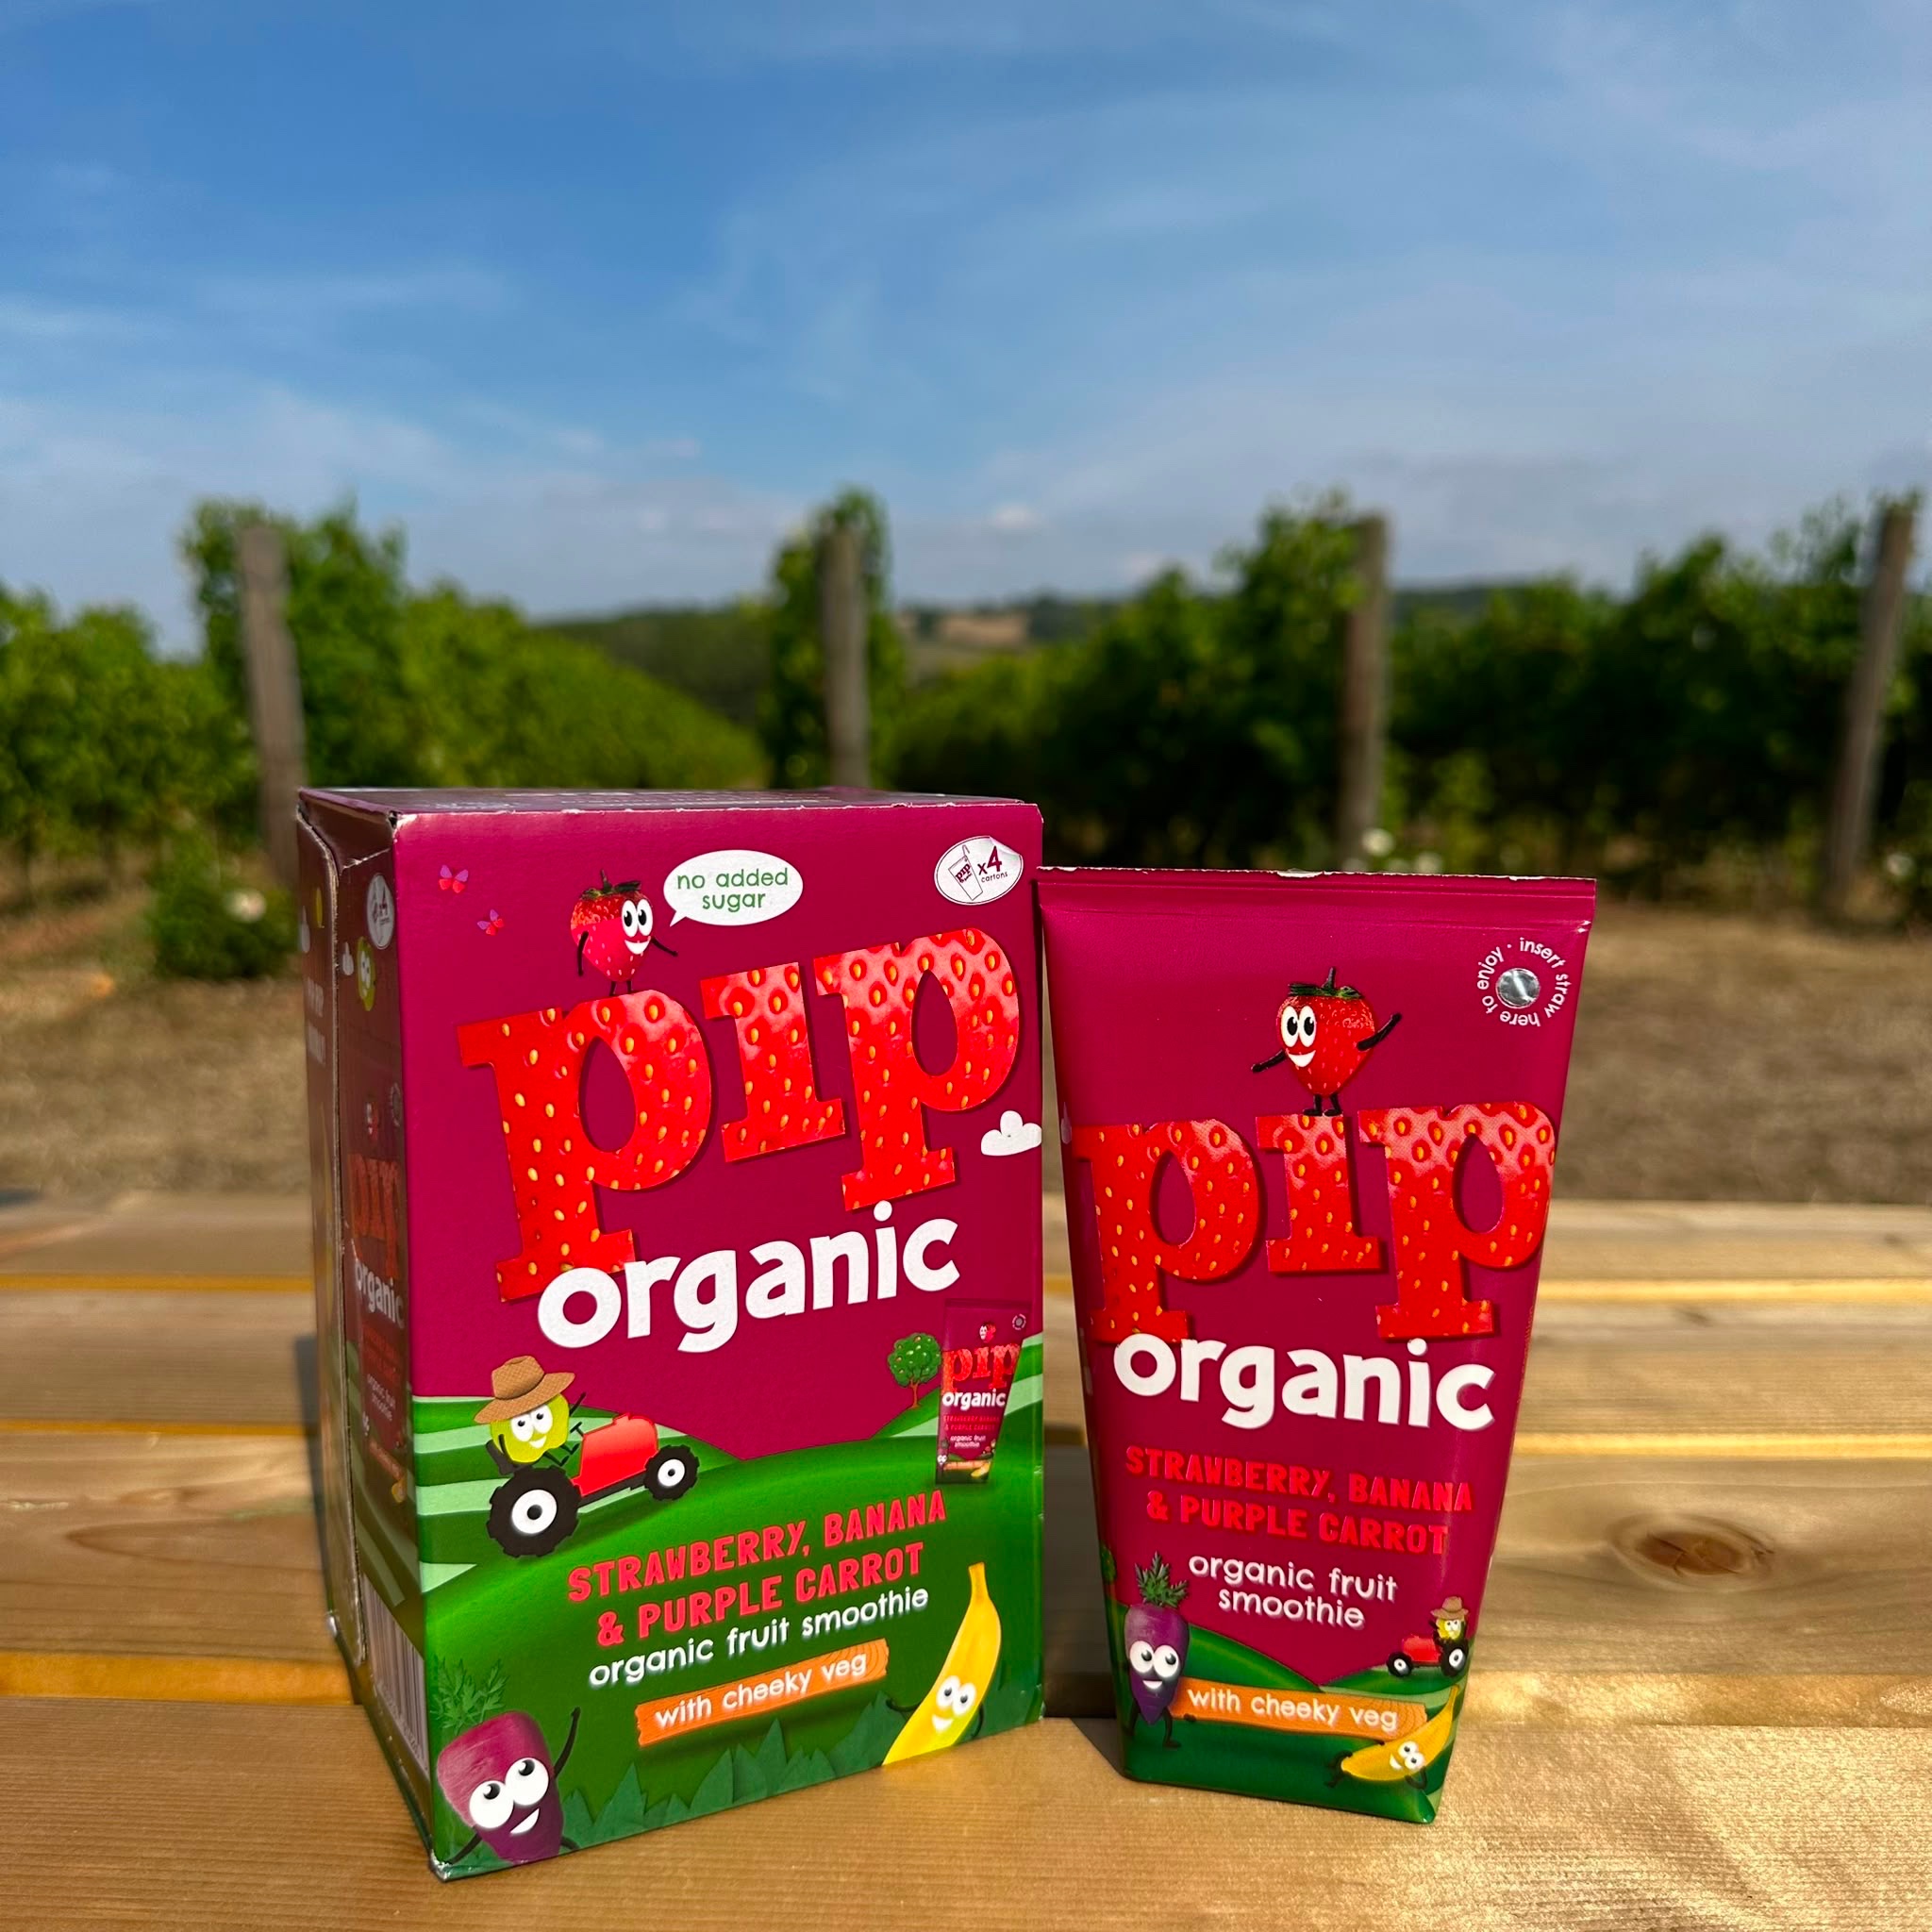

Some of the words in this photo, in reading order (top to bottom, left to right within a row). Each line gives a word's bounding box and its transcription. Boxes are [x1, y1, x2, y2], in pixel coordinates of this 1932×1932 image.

[677, 874, 706, 890] no
[715, 867, 788, 888] added
[977, 845, 1002, 875] x4
[981, 872, 1008, 883] cartons
[702, 892, 766, 913] sugar
[1476, 946, 1505, 990] enjoy
[1519, 937, 1566, 969] insert
[1481, 995, 1498, 1014] to
[1499, 1011, 1541, 1027] here
[1543, 974, 1572, 1018] straw
[457, 927, 1020, 1301] pip
[1073, 1101, 1556, 1341] pip
[355, 1258, 406, 1329] organic
[538, 1200, 960, 1353] organic
[941, 1343, 1020, 1396] pip
[1113, 1332, 1495, 1430] organic
[942, 1389, 1007, 1410] organic
[1125, 1446, 1337, 1503] STRAWBERRY,
[1348, 1473, 1473, 1511] BANANA
[567, 1519, 810, 1602] STRAWBERRY,
[824, 1490, 946, 1547] BANANA
[1146, 1491, 1168, 1521] &
[1180, 1495, 1307, 1539] PURPLE
[1319, 1515, 1449, 1555] CARROT
[596, 1610, 624, 1648] &
[638, 1575, 783, 1638] PURPLE
[796, 1542, 924, 1603] CARROT
[1189, 1556, 1315, 1591] organic
[1328, 1568, 1398, 1602] fruit
[1218, 1590, 1365, 1629] smoothie
[588, 1636, 714, 1689] organic
[726, 1617, 790, 1657] fruit
[802, 1587, 929, 1636] smoothie
[655, 1696, 712, 1728] with
[722, 1668, 812, 1712] cheeky
[821, 1652, 868, 1683] veg
[1187, 1688, 1241, 1713] with
[1250, 1694, 1341, 1727] cheeky
[1349, 1708, 1399, 1732] veg
